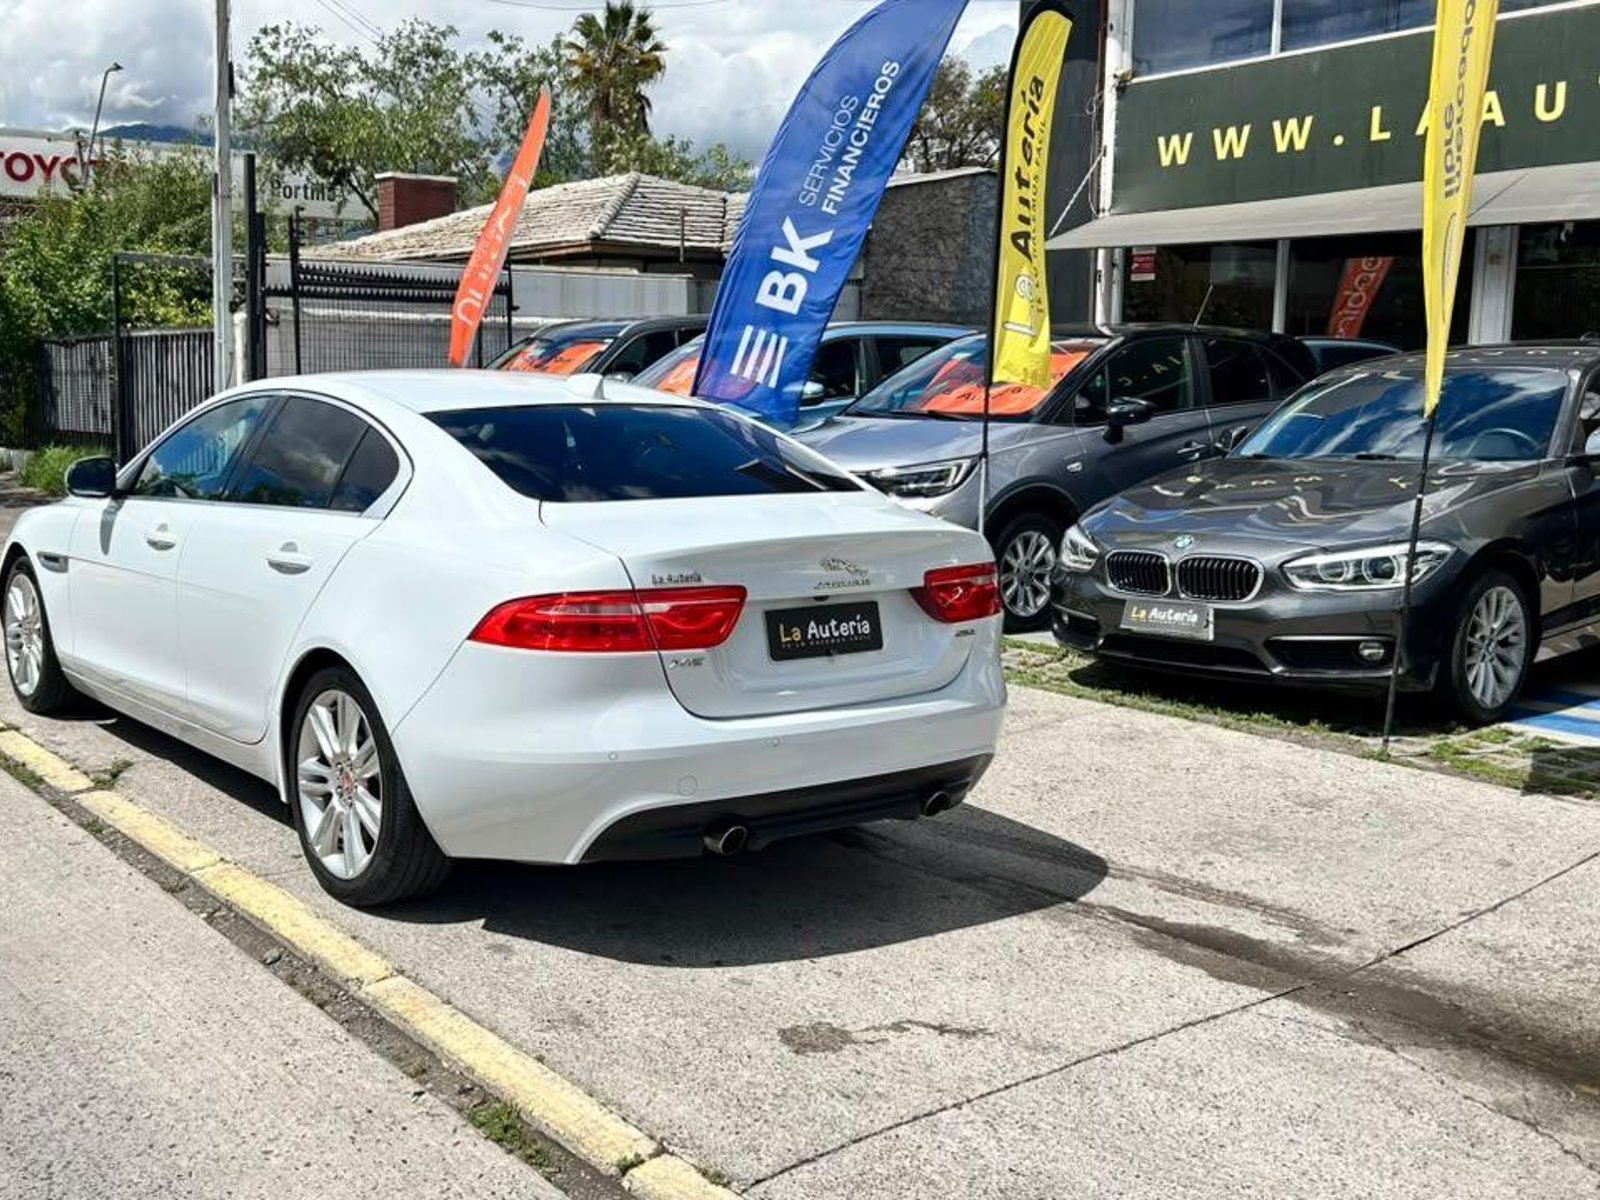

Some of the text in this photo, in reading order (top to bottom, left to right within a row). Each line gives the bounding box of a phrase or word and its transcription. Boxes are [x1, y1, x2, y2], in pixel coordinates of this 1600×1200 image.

[0, 150, 110, 186] OYO
[799, 94, 858, 207] SERVICIOS
[821, 60, 900, 216] FINANCIEROS
[1009, 75, 1045, 264] Autería
[1157, 75, 1600, 168] WWW.LAU
[754, 215, 835, 316] BK
[779, 622, 802, 642] La
[807, 613, 870, 640] Autería
[1131, 606, 1198, 623] La Autería
